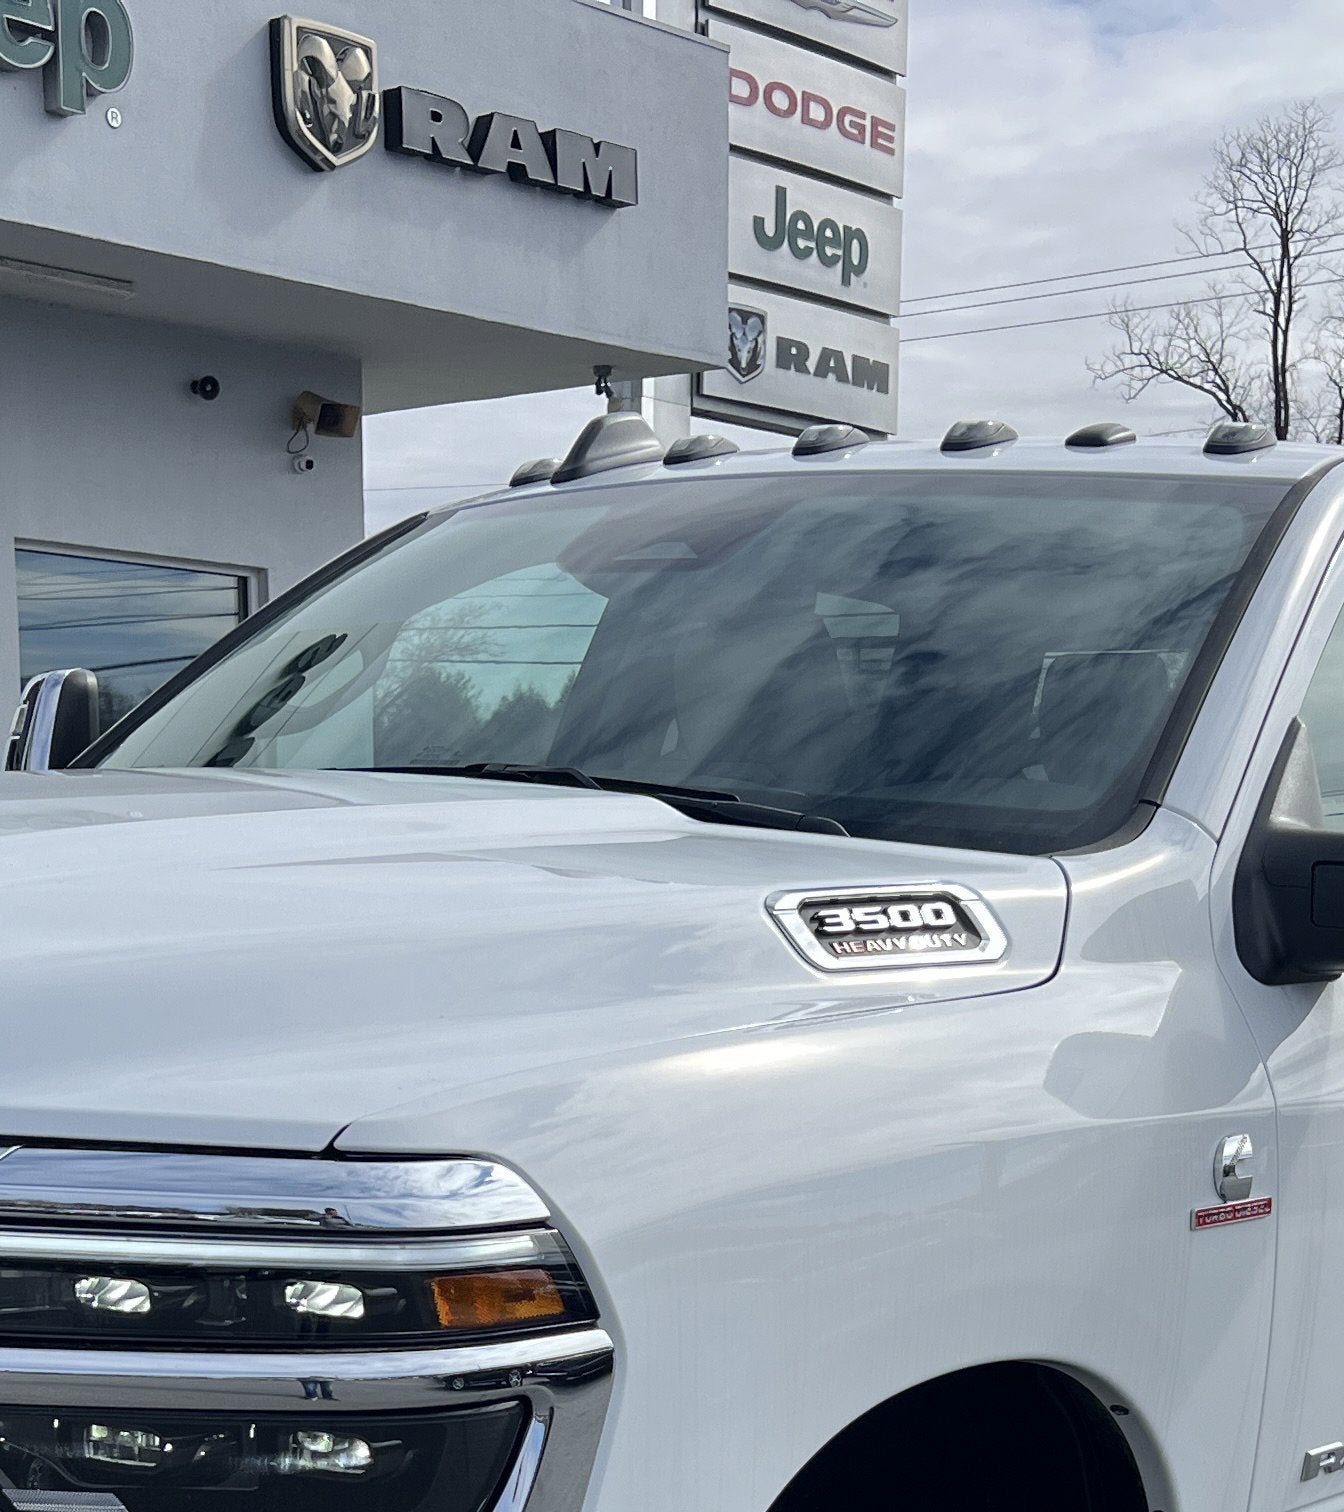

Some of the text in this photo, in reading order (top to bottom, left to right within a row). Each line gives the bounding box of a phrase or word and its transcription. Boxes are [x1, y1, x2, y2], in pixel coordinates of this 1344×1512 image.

[382, 85, 639, 208] RAM
[728, 68, 896, 156] DODGE
[753, 184, 870, 288] Jeep
[775, 335, 891, 395] RAM
[812, 901, 957, 935] 3500
[831, 936, 908, 955] HEAVY
